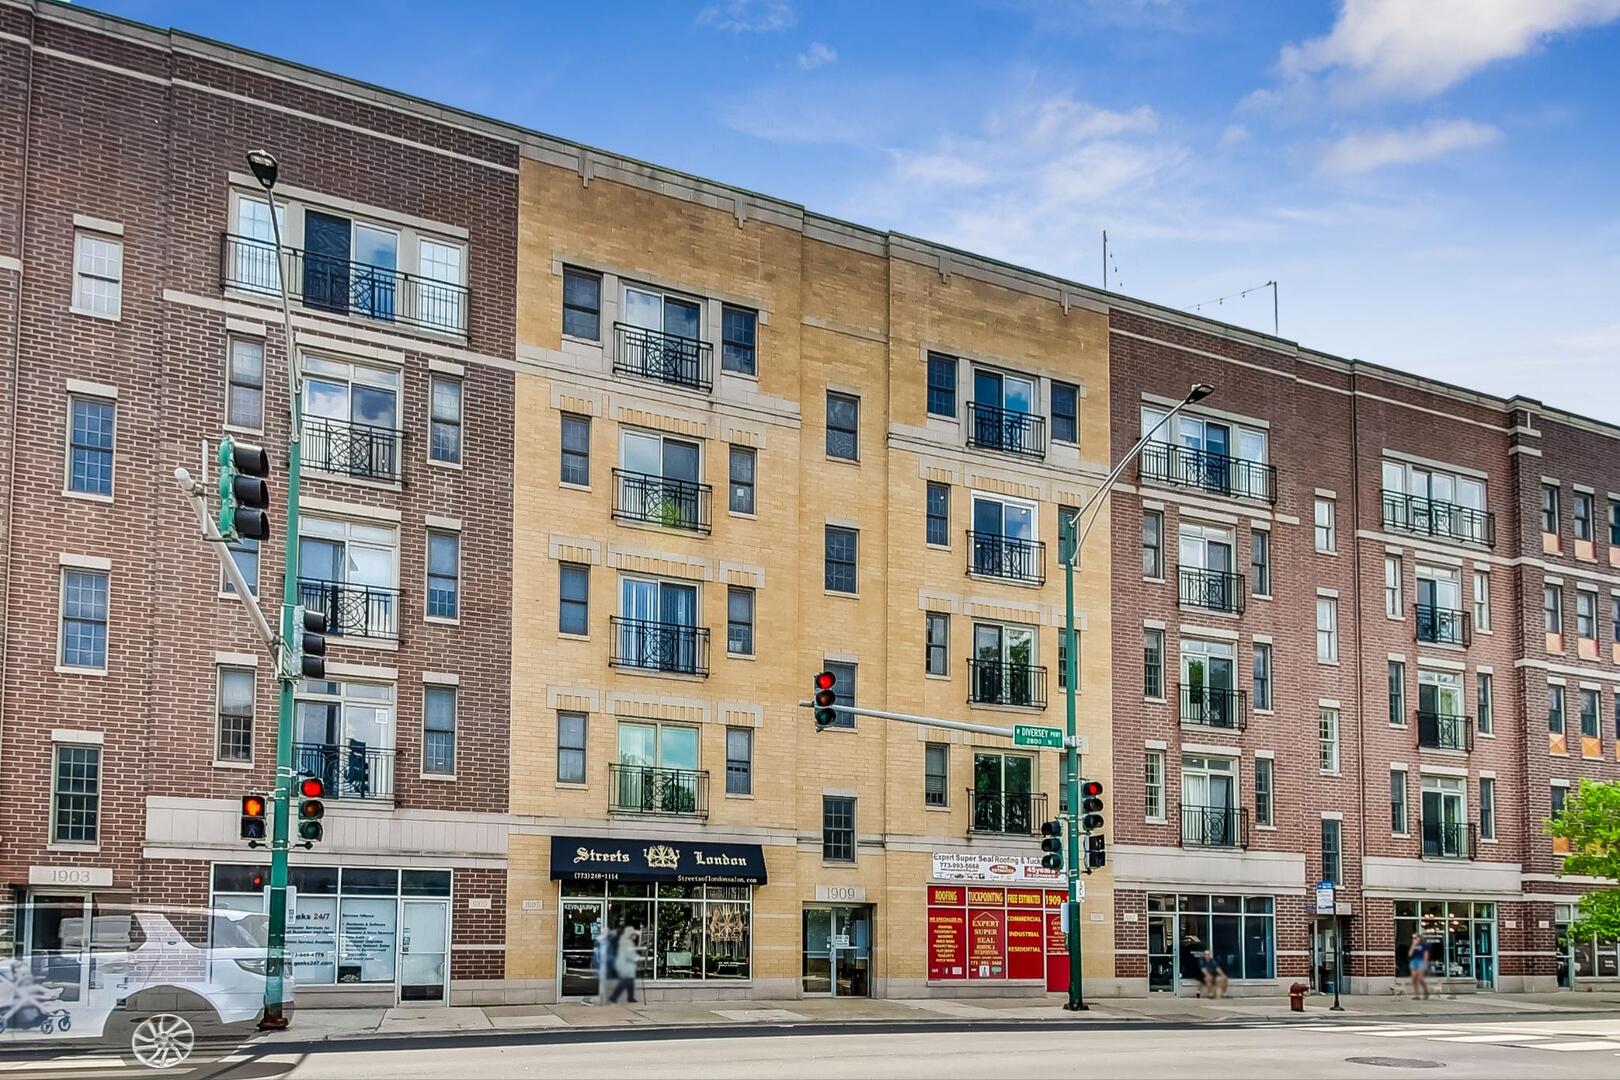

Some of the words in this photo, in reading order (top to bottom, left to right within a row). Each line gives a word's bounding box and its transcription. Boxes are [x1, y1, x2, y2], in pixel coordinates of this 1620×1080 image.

[1021, 727, 1048, 738] DIVERSEY
[573, 847, 630, 864] Streets
[693, 850, 747, 866] London
[995, 856, 1018, 865] Roofing
[52, 870, 90, 882] 1903
[827, 887, 855, 899] 1909
[935, 891, 957, 901] ROOFING
[968, 892, 1003, 902] TUCKPOINTING
[1008, 894, 1018, 903] FREE
[1019, 895, 1041, 904] ESTIMATES
[1045, 895, 1061, 905] 1909
